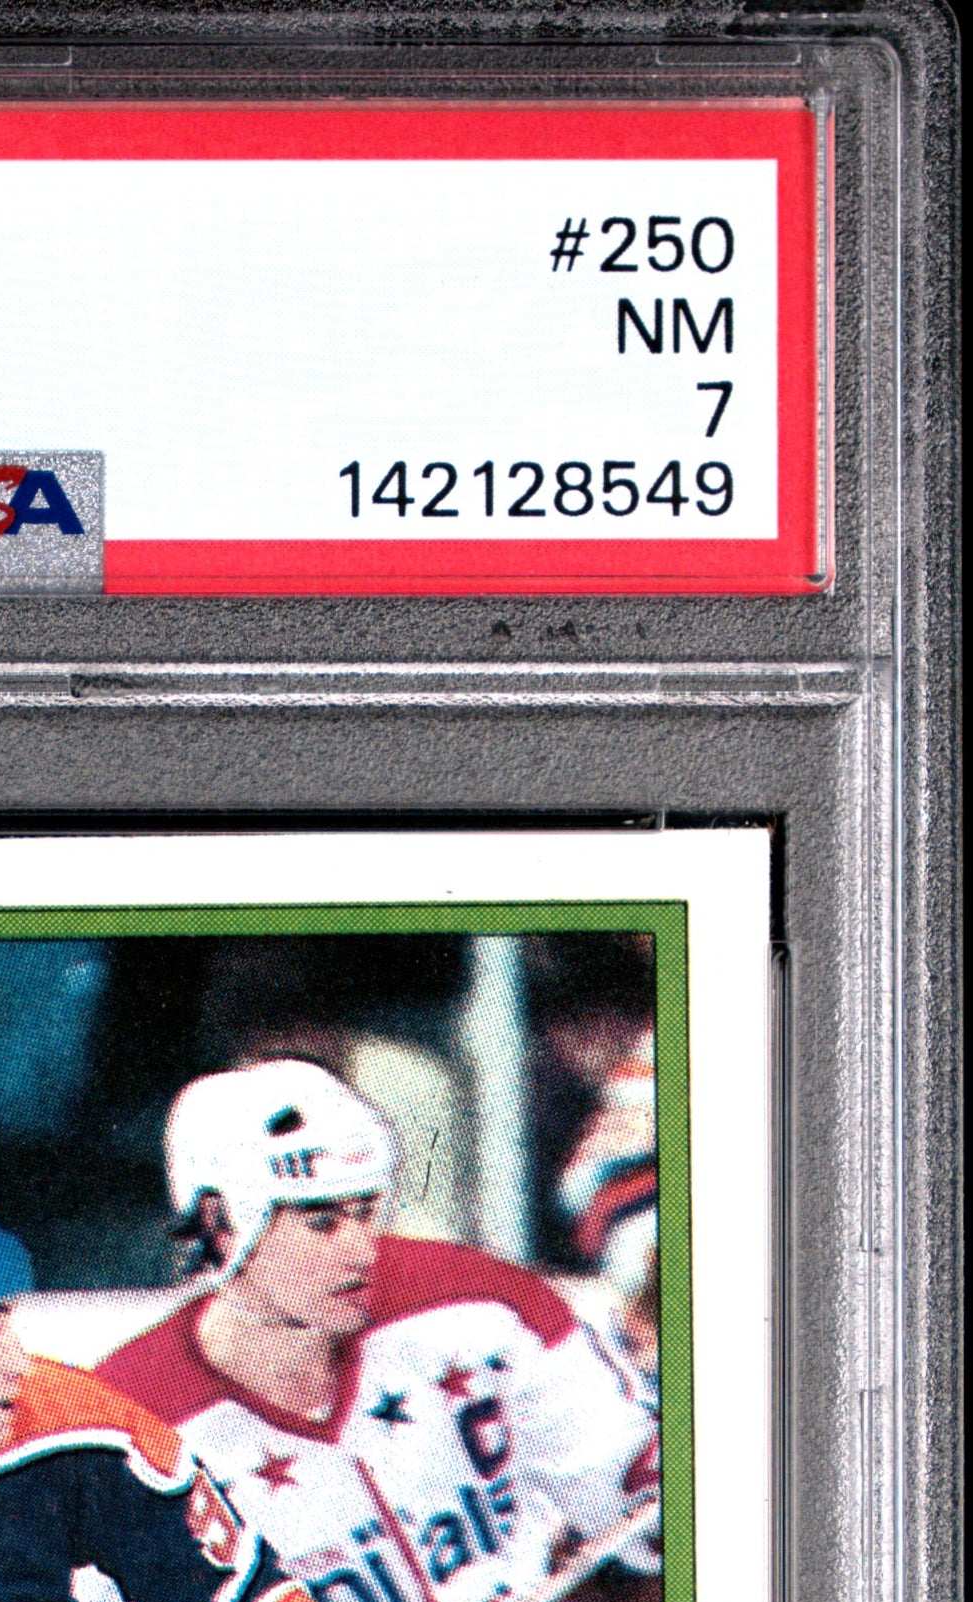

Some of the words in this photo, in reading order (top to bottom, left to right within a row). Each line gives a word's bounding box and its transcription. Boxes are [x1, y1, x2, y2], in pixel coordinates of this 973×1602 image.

[549, 214, 735, 275] #250
[616, 296, 735, 355] NM
[695, 380, 734, 439] 7
[338, 459, 734, 519] 142128549
